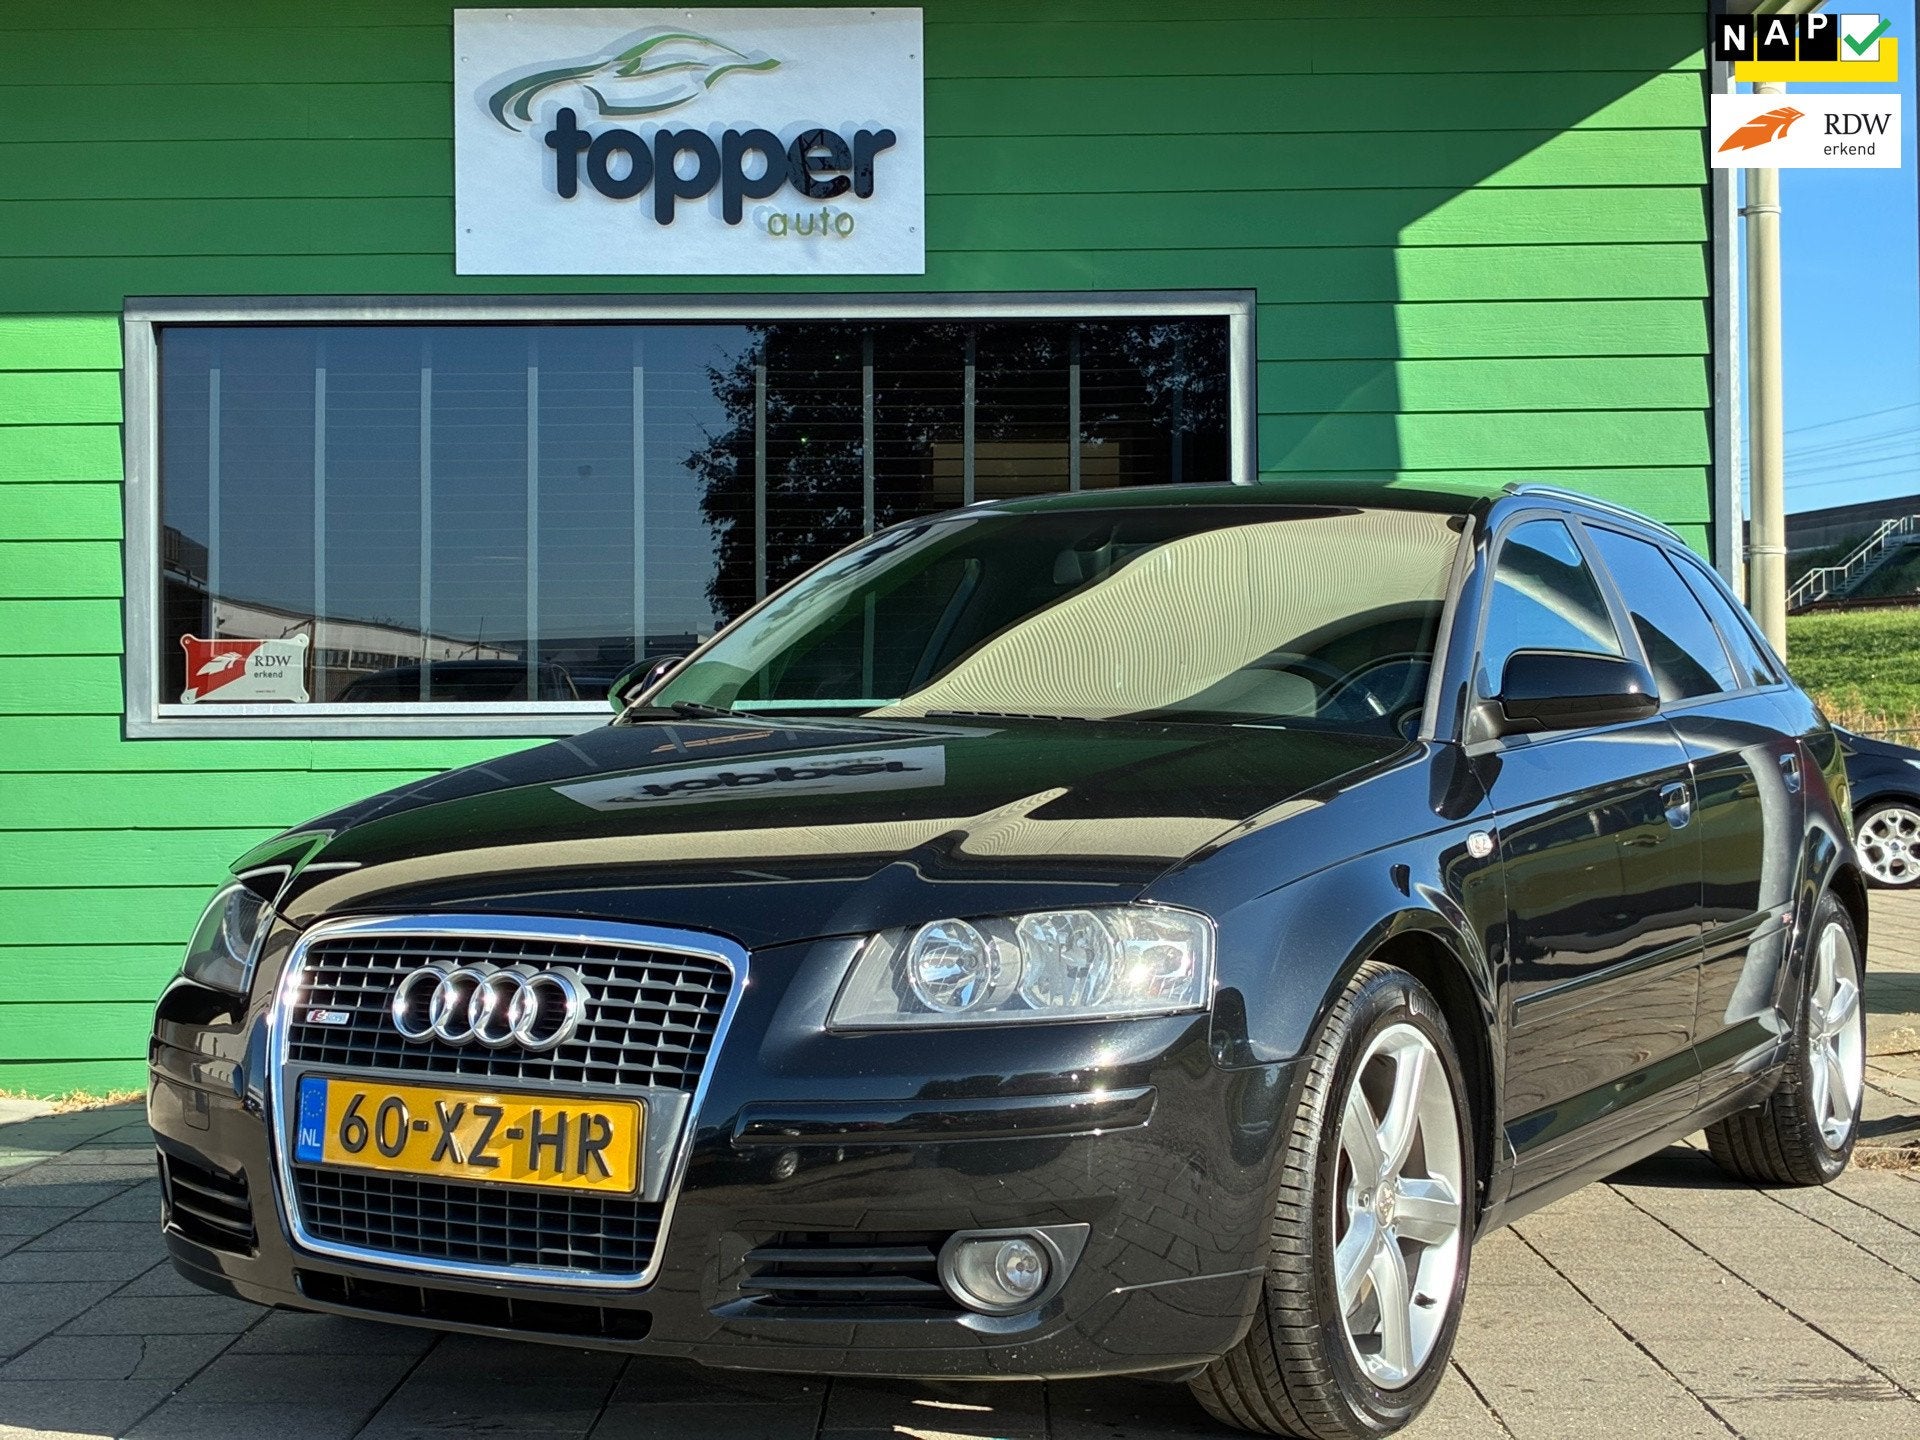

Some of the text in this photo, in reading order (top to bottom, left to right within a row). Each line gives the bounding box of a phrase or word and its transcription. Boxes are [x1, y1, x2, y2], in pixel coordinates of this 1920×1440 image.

[544, 107, 897, 226] topper
[767, 206, 855, 238] auto
[254, 655, 292, 667] RDW
[253, 671, 283, 679] erkend
[301, 1127, 321, 1147] NL
[338, 1093, 614, 1178] 60-XZ-HR
